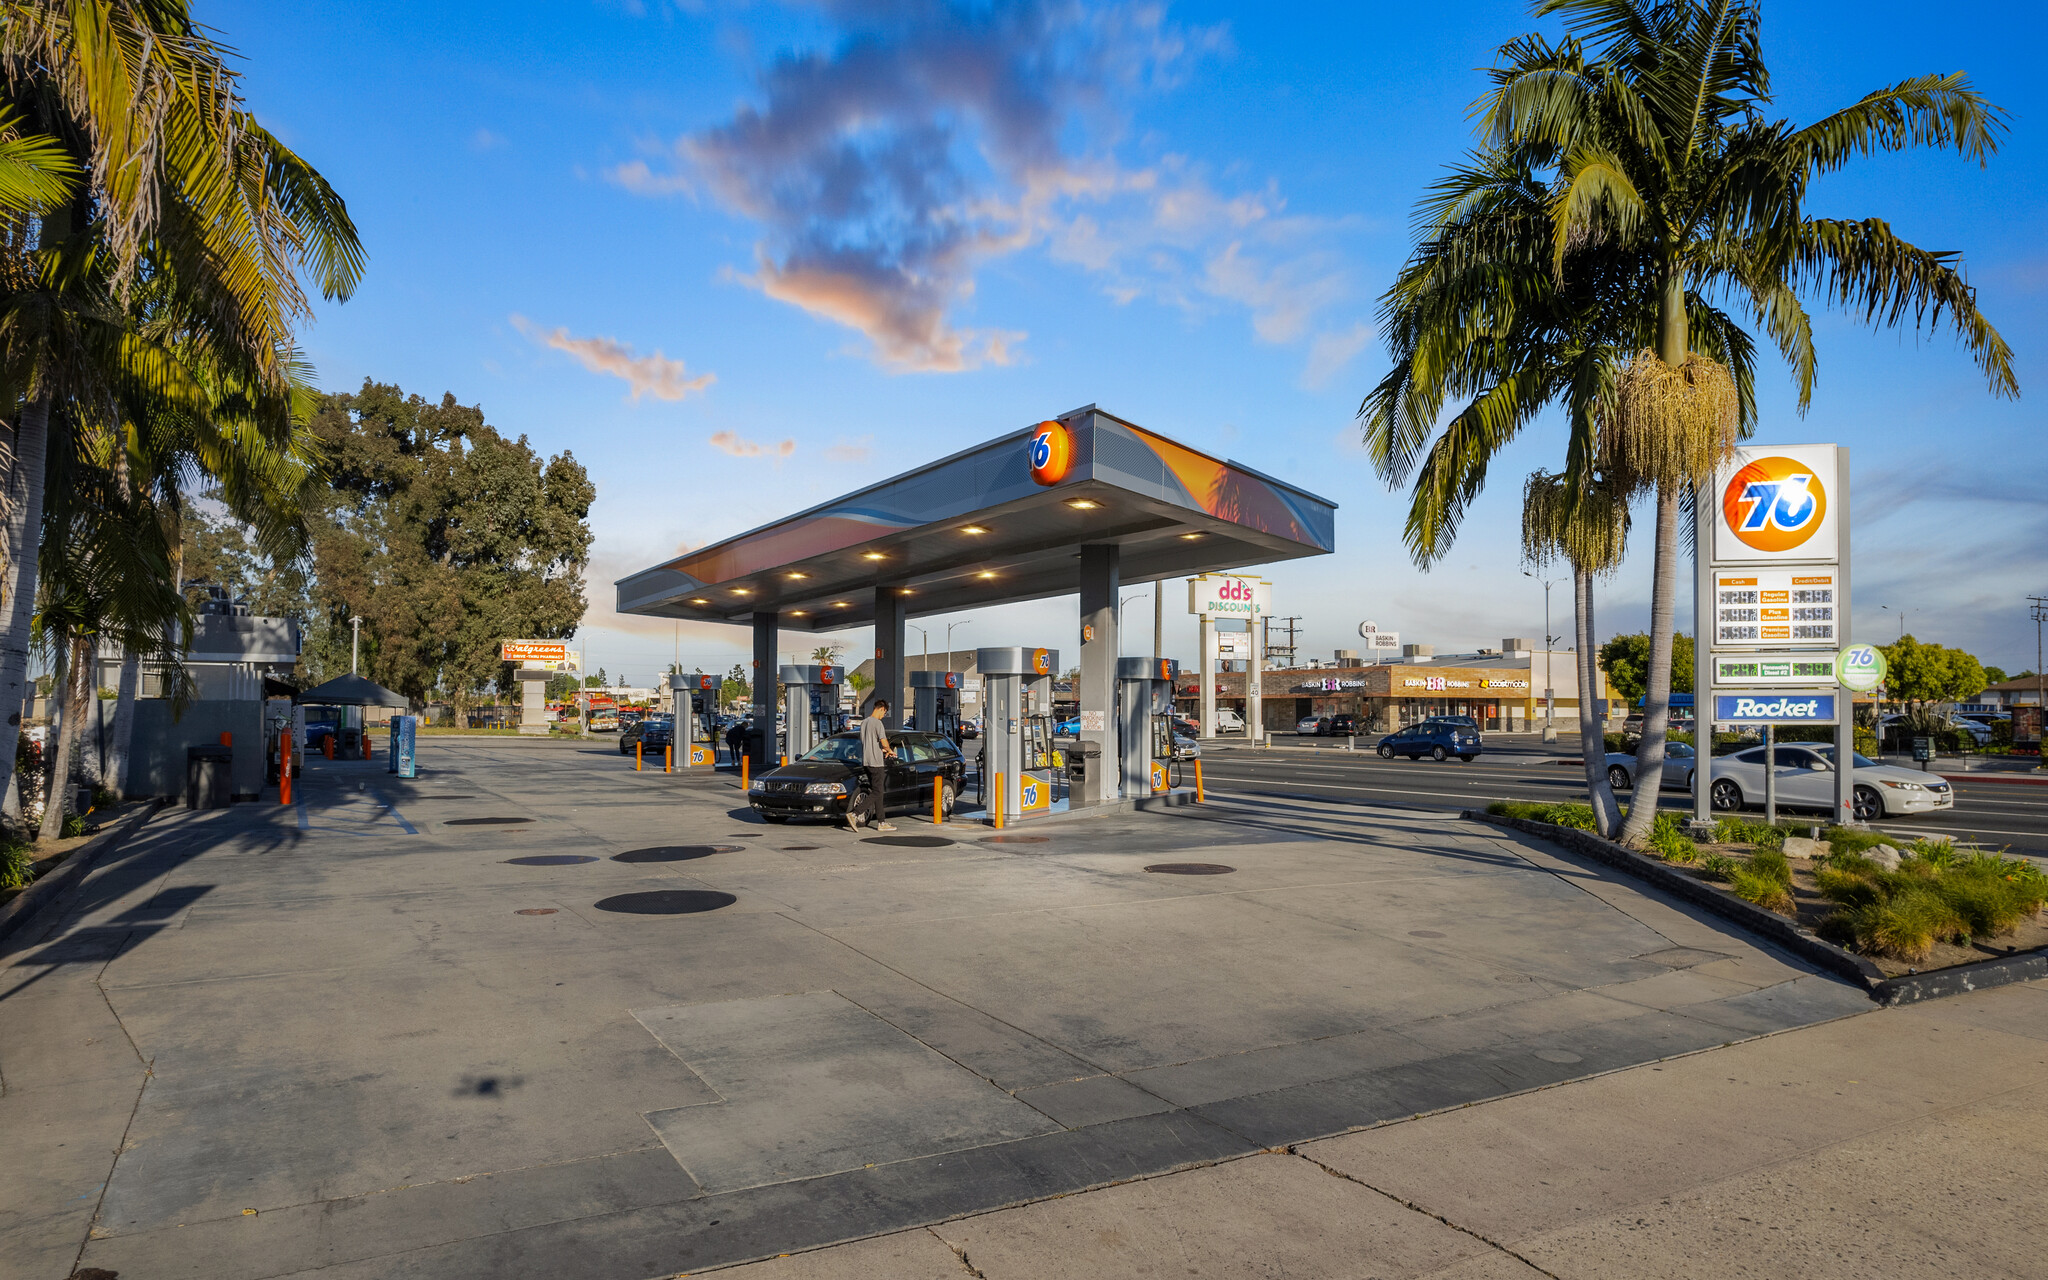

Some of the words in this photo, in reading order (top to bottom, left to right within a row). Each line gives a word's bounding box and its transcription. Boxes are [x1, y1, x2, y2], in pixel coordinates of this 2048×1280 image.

[1738, 473, 1817, 532] 76
[1219, 580, 1252, 601] dd's
[1208, 601, 1261, 613] DISCOUNS
[1365, 625, 1376, 633] BR
[505, 644, 563, 654] Walgreens
[1848, 647, 1875, 667] 76
[824, 669, 834, 680] 76
[1321, 677, 1341, 691] BR
[1403, 679, 1425, 687] BASKIN
[1425, 677, 1446, 691] BR
[1446, 680, 1470, 688] ROBBINS
[1733, 698, 1818, 718] Rocket
[692, 750, 704, 763] 76
[1152, 768, 1162, 788] 76
[1023, 783, 1037, 807] 76
